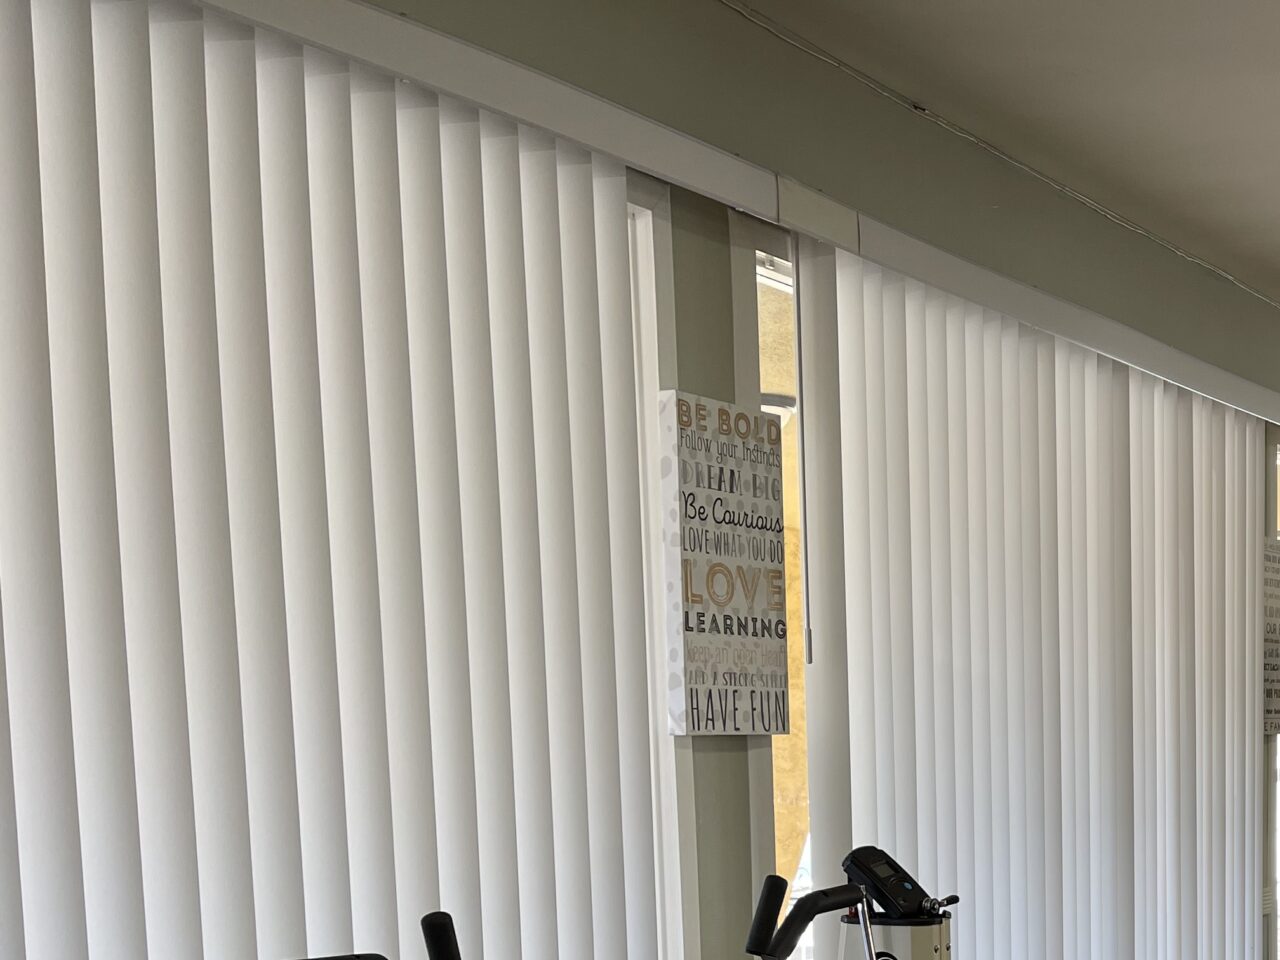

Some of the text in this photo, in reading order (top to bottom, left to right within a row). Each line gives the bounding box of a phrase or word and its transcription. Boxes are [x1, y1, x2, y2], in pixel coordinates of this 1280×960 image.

[678, 399, 781, 446] BE BOLD
[680, 428, 781, 468] Follow your Instincts
[682, 459, 781, 501] DREAM BIG
[682, 491, 784, 533] Be Courious
[682, 526, 783, 564] LOVE WHAT YOU DO
[683, 558, 784, 612] LOVE
[684, 611, 786, 639] LEARNING
[690, 688, 786, 732] HAVE FUN
